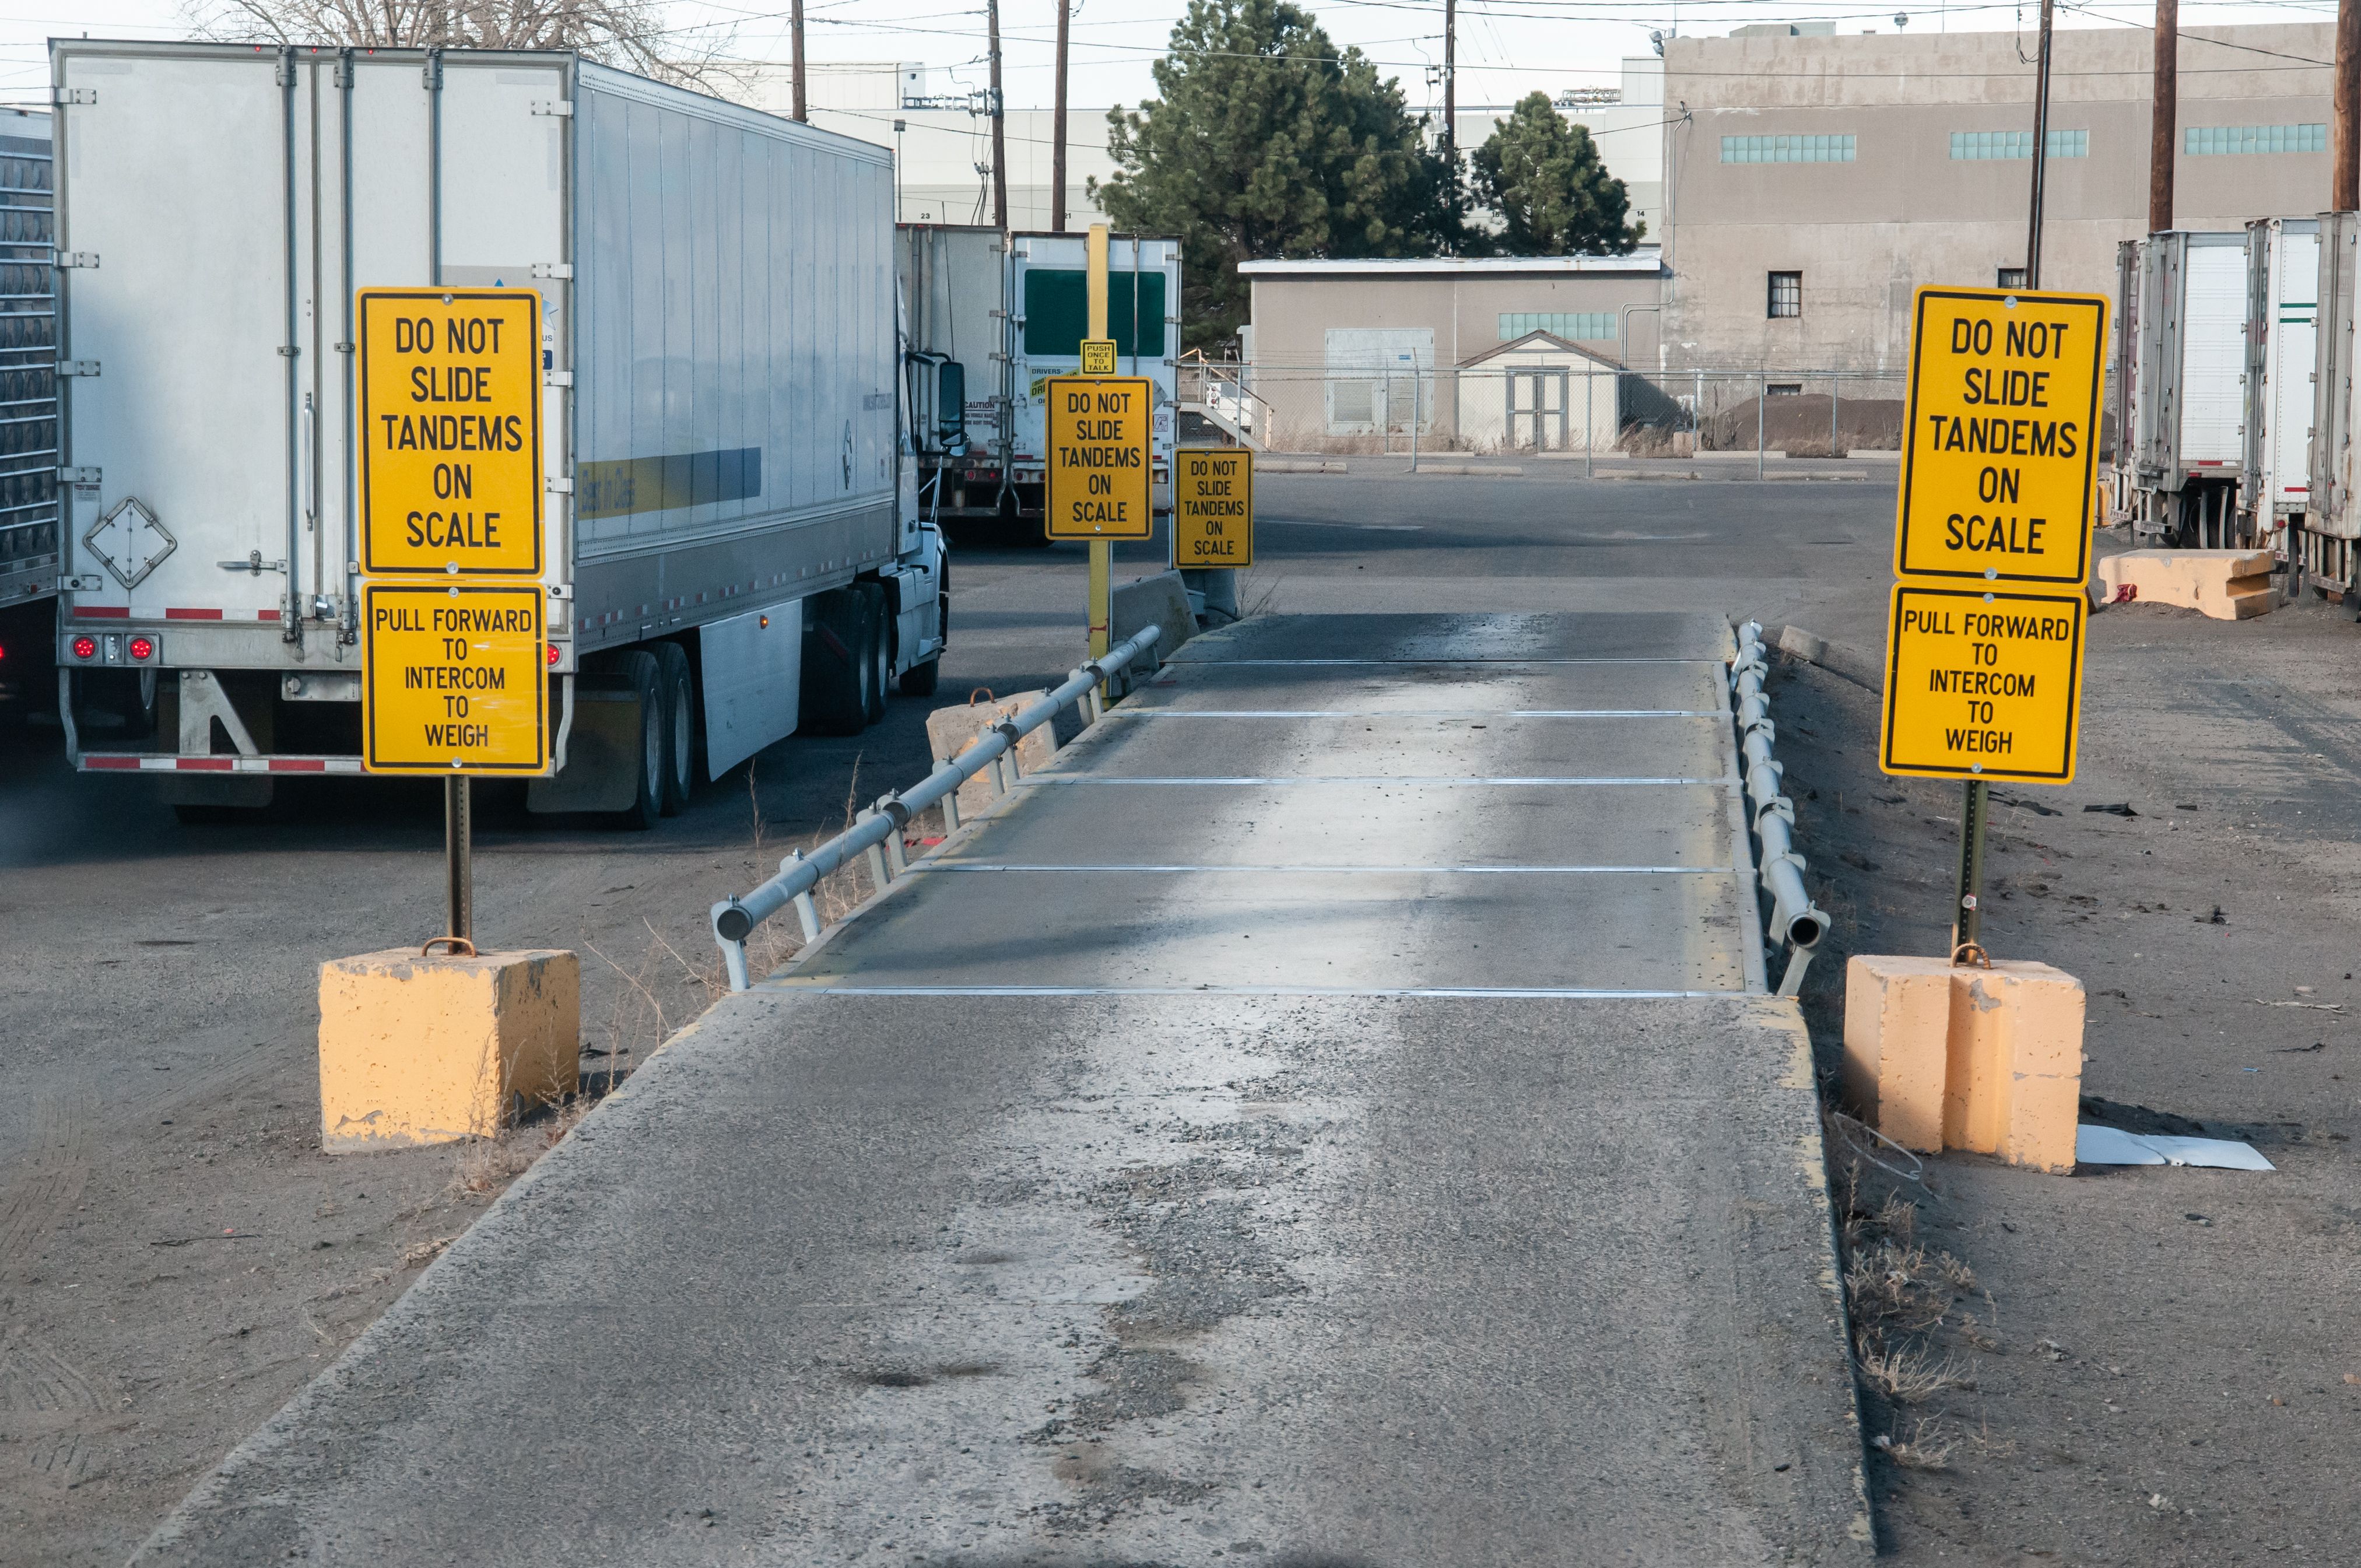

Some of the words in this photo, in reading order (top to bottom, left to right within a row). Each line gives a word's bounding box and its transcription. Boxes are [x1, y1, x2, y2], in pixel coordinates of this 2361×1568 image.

[397, 318, 433, 354] DO
[448, 318, 504, 354] NOT
[1952, 318, 1992, 356] DO
[2006, 321, 2069, 359] NOT
[412, 366, 491, 402] SLIDE
[1963, 367, 2050, 408] SLIDE
[1068, 393, 1090, 413] DO
[1098, 393, 1131, 413] NOT
[381, 415, 522, 452] TANDEMS
[1077, 420, 1123, 441] SLIDE
[1929, 415, 2077, 458] TANDEMS
[1059, 447, 1141, 468] TANDEMS
[1191, 461, 1208, 476] DO
[1213, 461, 1237, 476] NOT
[434, 464, 472, 500] ON
[1089, 473, 1111, 495] ON
[1198, 480, 1232, 496] SLIDE
[1978, 466, 2020, 504] ON
[1072, 501, 1127, 522] SCALE
[1185, 500, 1244, 516] TANDEMS
[407, 511, 501, 548] SCALE
[1206, 521, 1223, 536] ON
[1945, 513, 2046, 555] SCALE
[1194, 540, 1234, 556] SCALE
[376, 609, 425, 632] PULL
[434, 609, 531, 632] FORWARD
[1904, 610, 1955, 636] PULL
[1964, 613, 2069, 641] FORWARD
[443, 638, 467, 661] TO
[1971, 643, 1998, 666] TO
[405, 667, 504, 689] INTERCOM
[1930, 669, 2035, 698] INTERCOM
[443, 695, 468, 718] TO
[1967, 700, 1994, 724] TO
[424, 724, 488, 747] WEIGH
[1945, 728, 2012, 754] WEIGH
